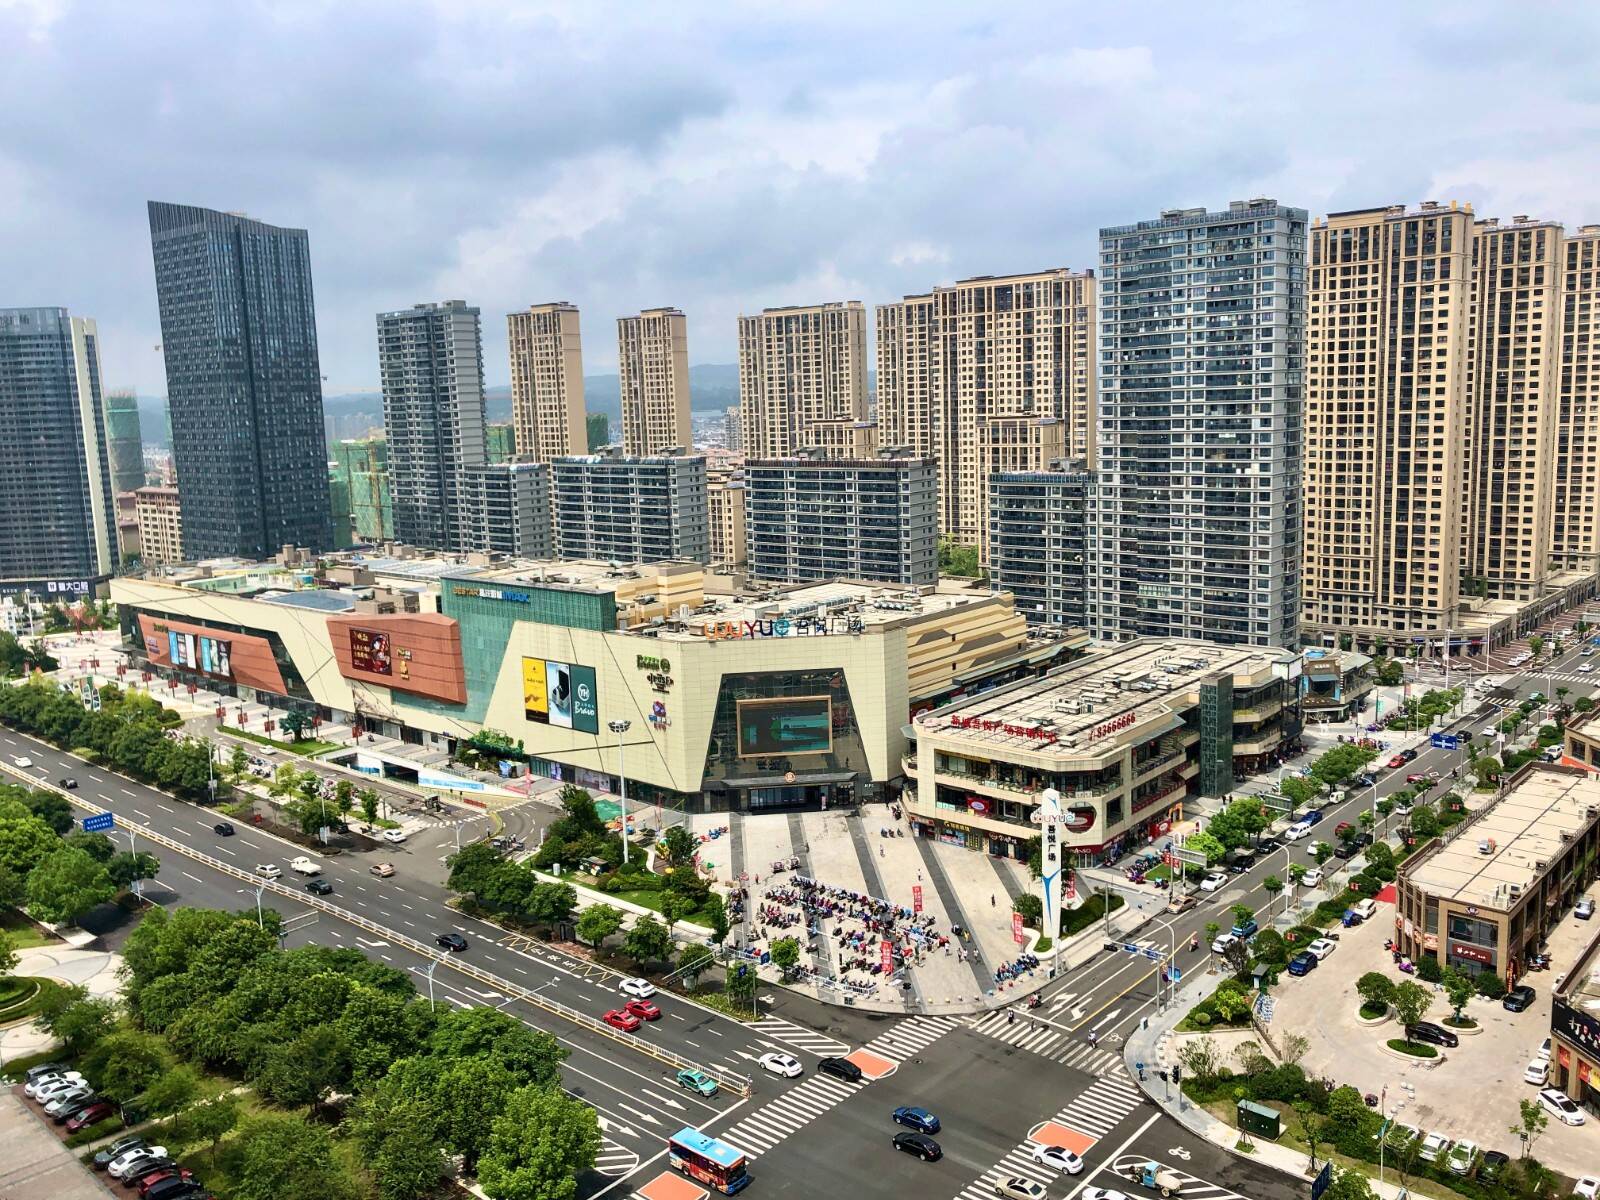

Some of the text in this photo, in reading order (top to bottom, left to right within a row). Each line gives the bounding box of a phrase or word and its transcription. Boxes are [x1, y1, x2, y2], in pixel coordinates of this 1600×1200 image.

[797, 615, 863, 636] 吾悦广场
[574, 701, 595, 716] Bravo
[1047, 825, 1056, 861] 吾悦广场
